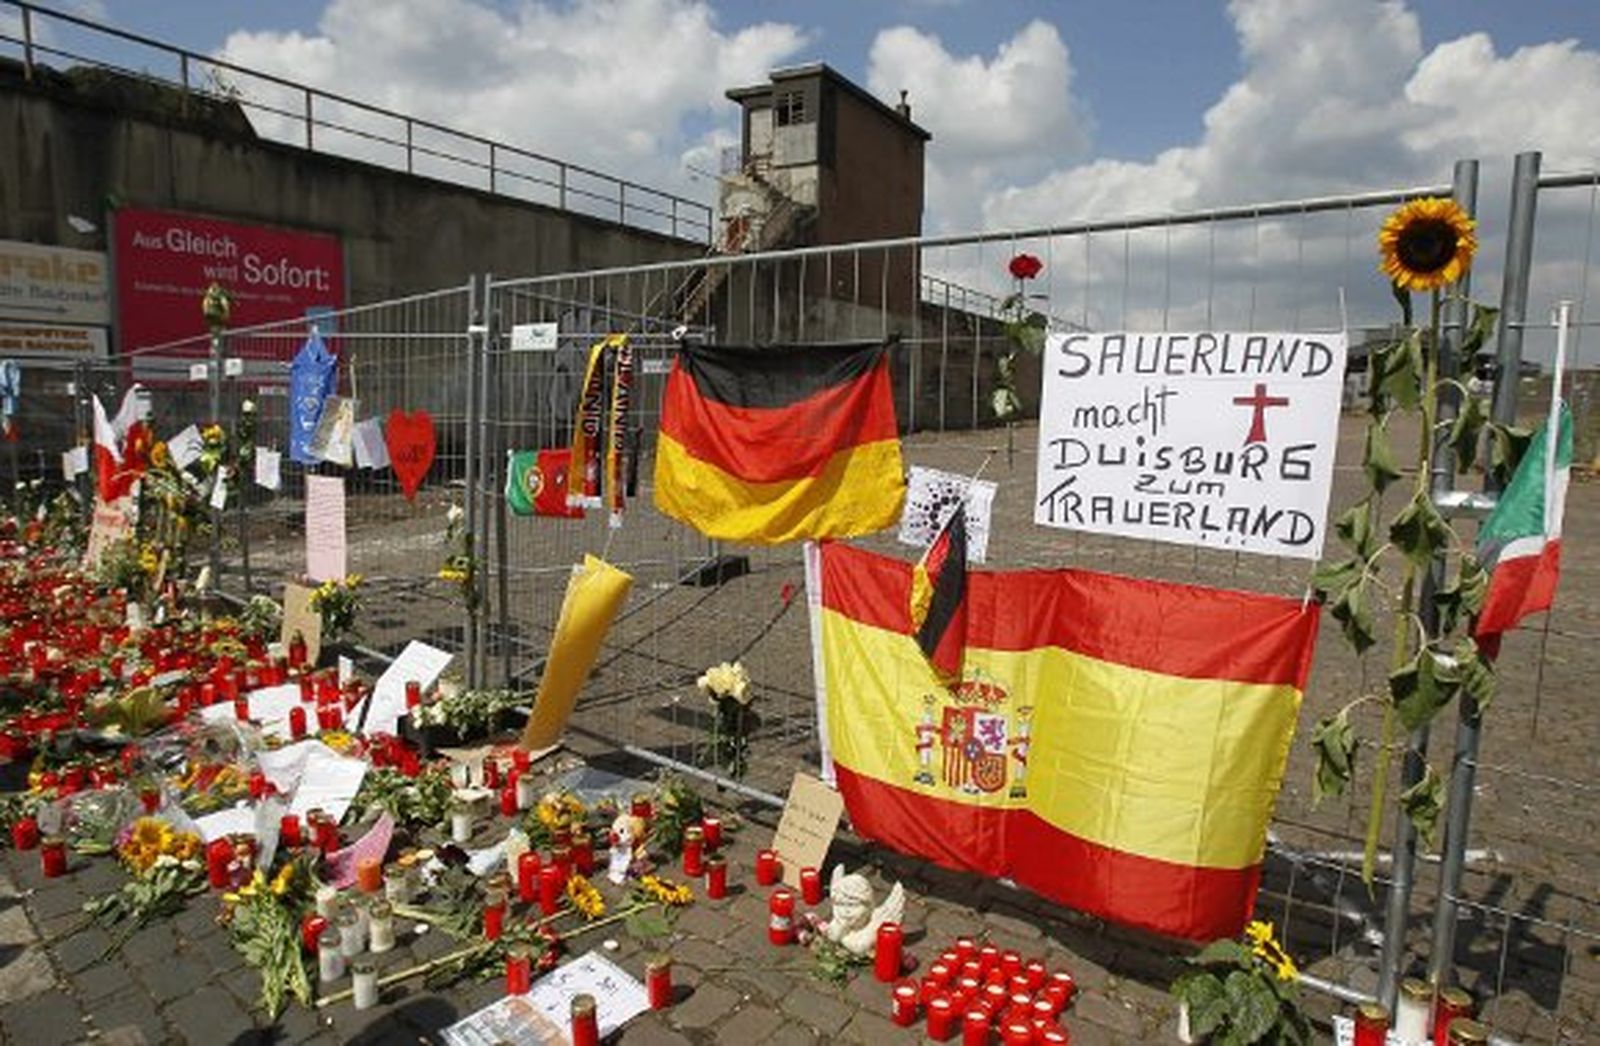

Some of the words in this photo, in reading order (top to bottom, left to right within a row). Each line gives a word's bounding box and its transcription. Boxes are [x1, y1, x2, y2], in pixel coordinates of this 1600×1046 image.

[132, 231, 163, 249] Aus
[165, 228, 238, 258] Gleich
[203, 262, 238, 282] wird
[244, 254, 330, 292] Sofort:
[1059, 333, 1333, 379] SAUERLAND
[1072, 385, 1178, 436] macht
[1039, 475, 1315, 546] TRAUERLAND
